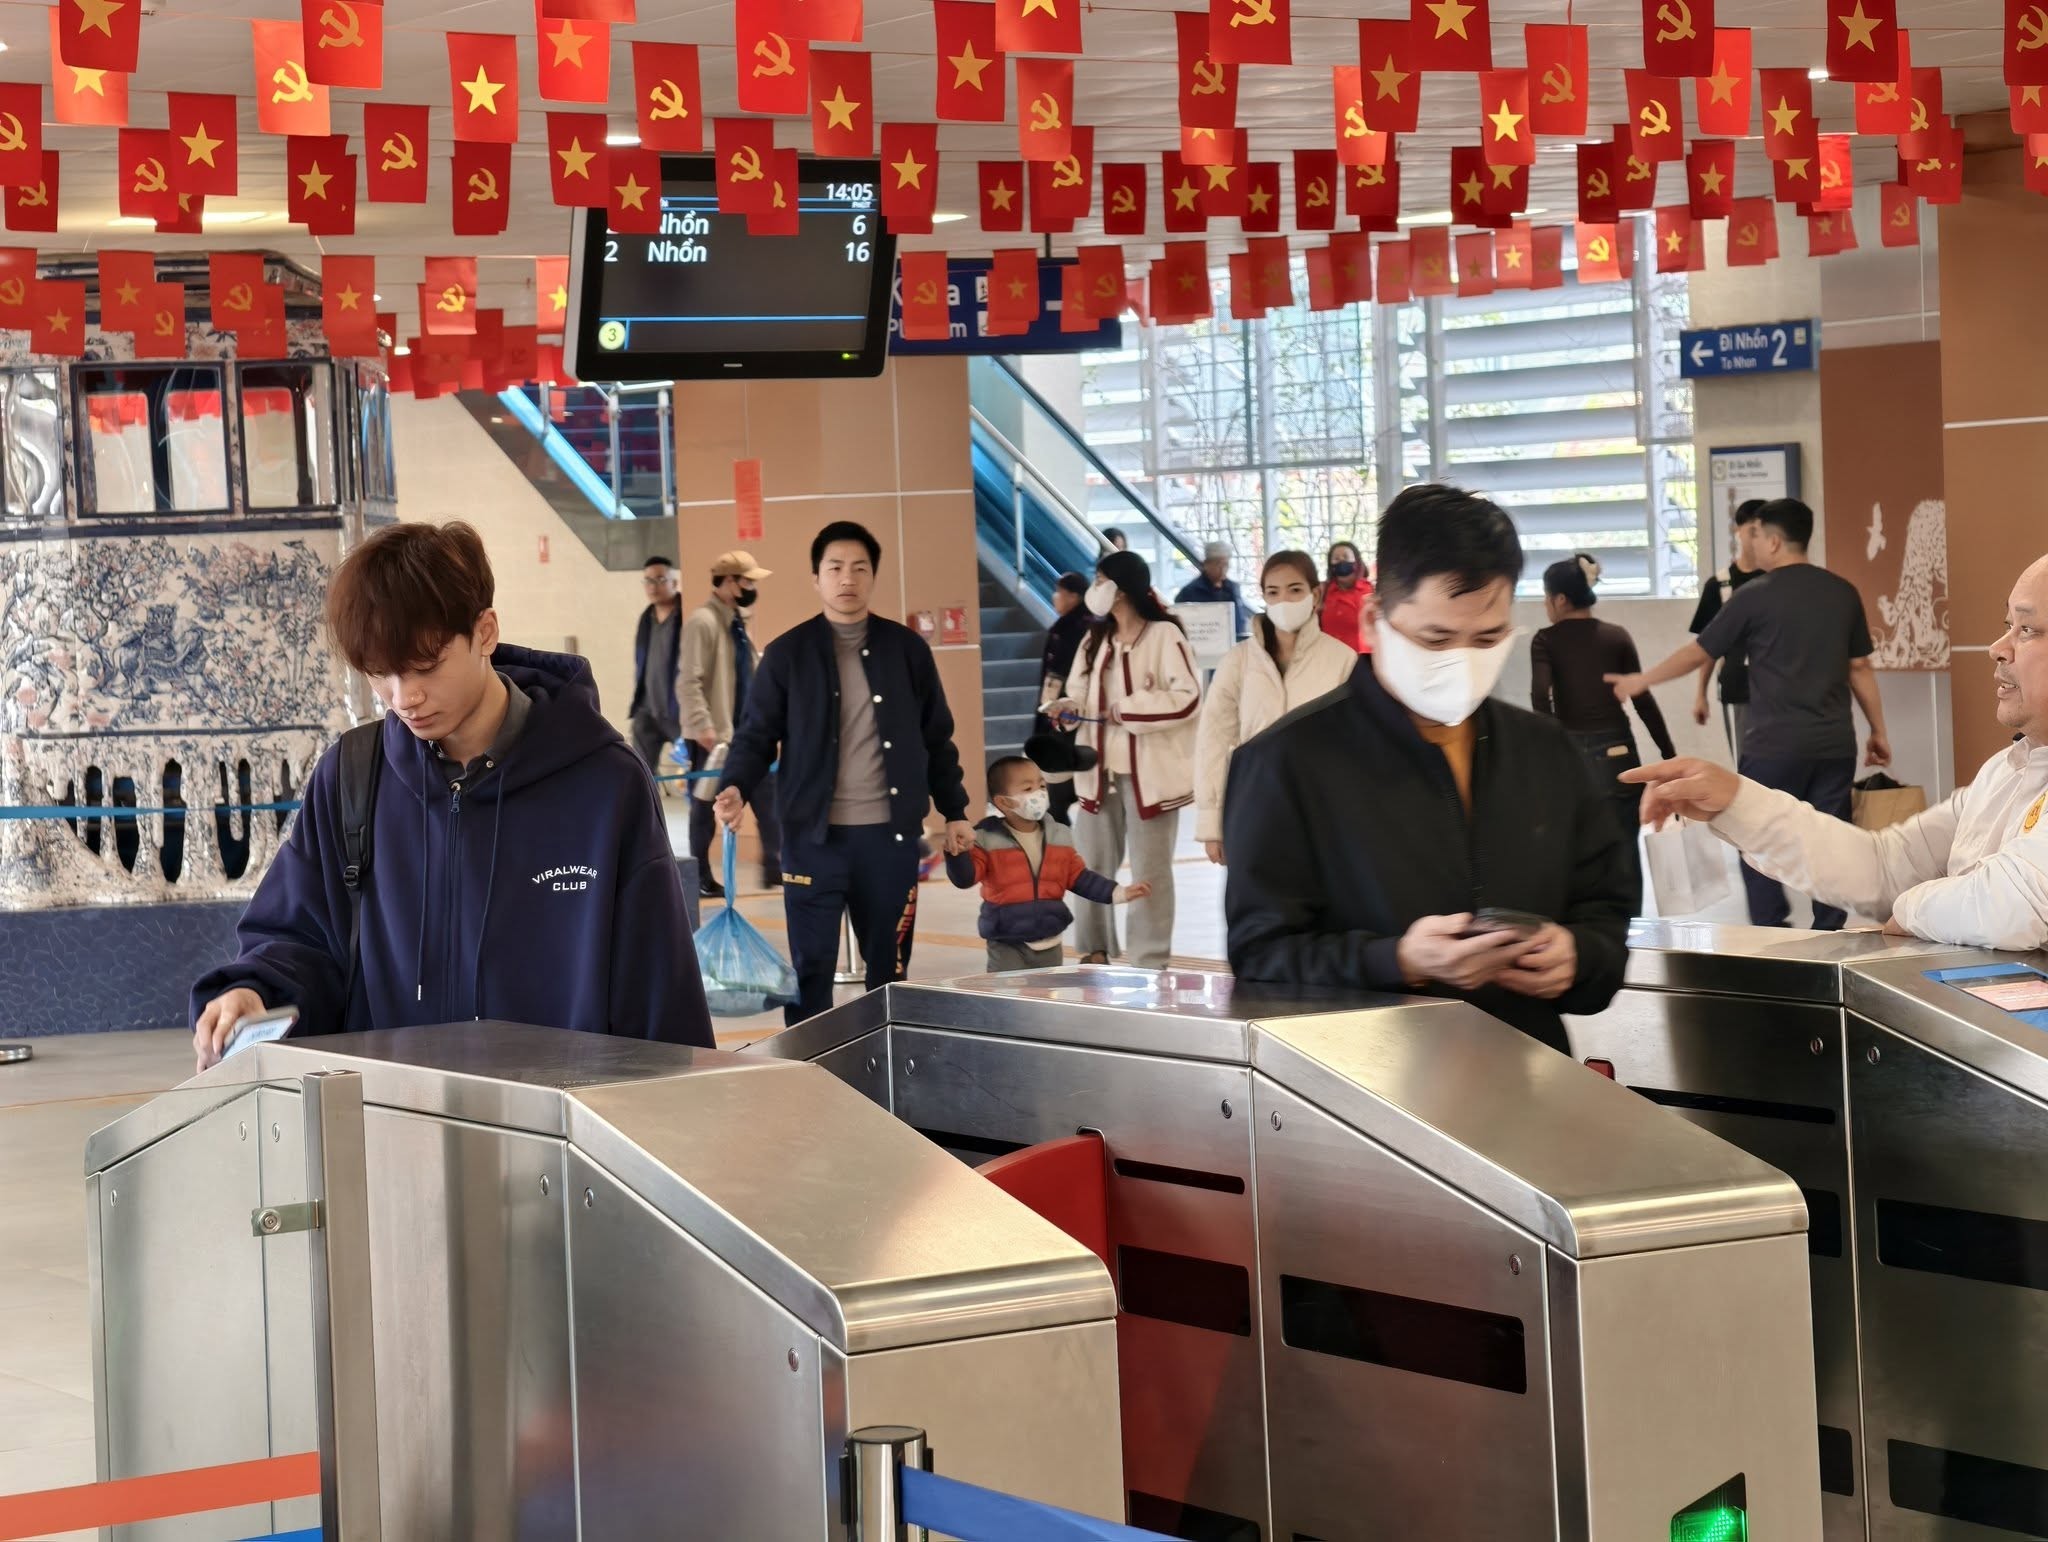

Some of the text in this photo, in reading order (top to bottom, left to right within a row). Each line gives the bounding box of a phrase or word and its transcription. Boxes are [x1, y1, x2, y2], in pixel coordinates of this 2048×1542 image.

[826, 183, 873, 201] 14:05
[852, 215, 867, 235] 6
[603, 240, 619, 262] 2
[845, 242, 870, 262] 16
[607, 328, 617, 342] 3
[1771, 329, 1788, 366] 2
[532, 865, 598, 884] VIRALWEAR
[552, 881, 587, 891] CLUB
